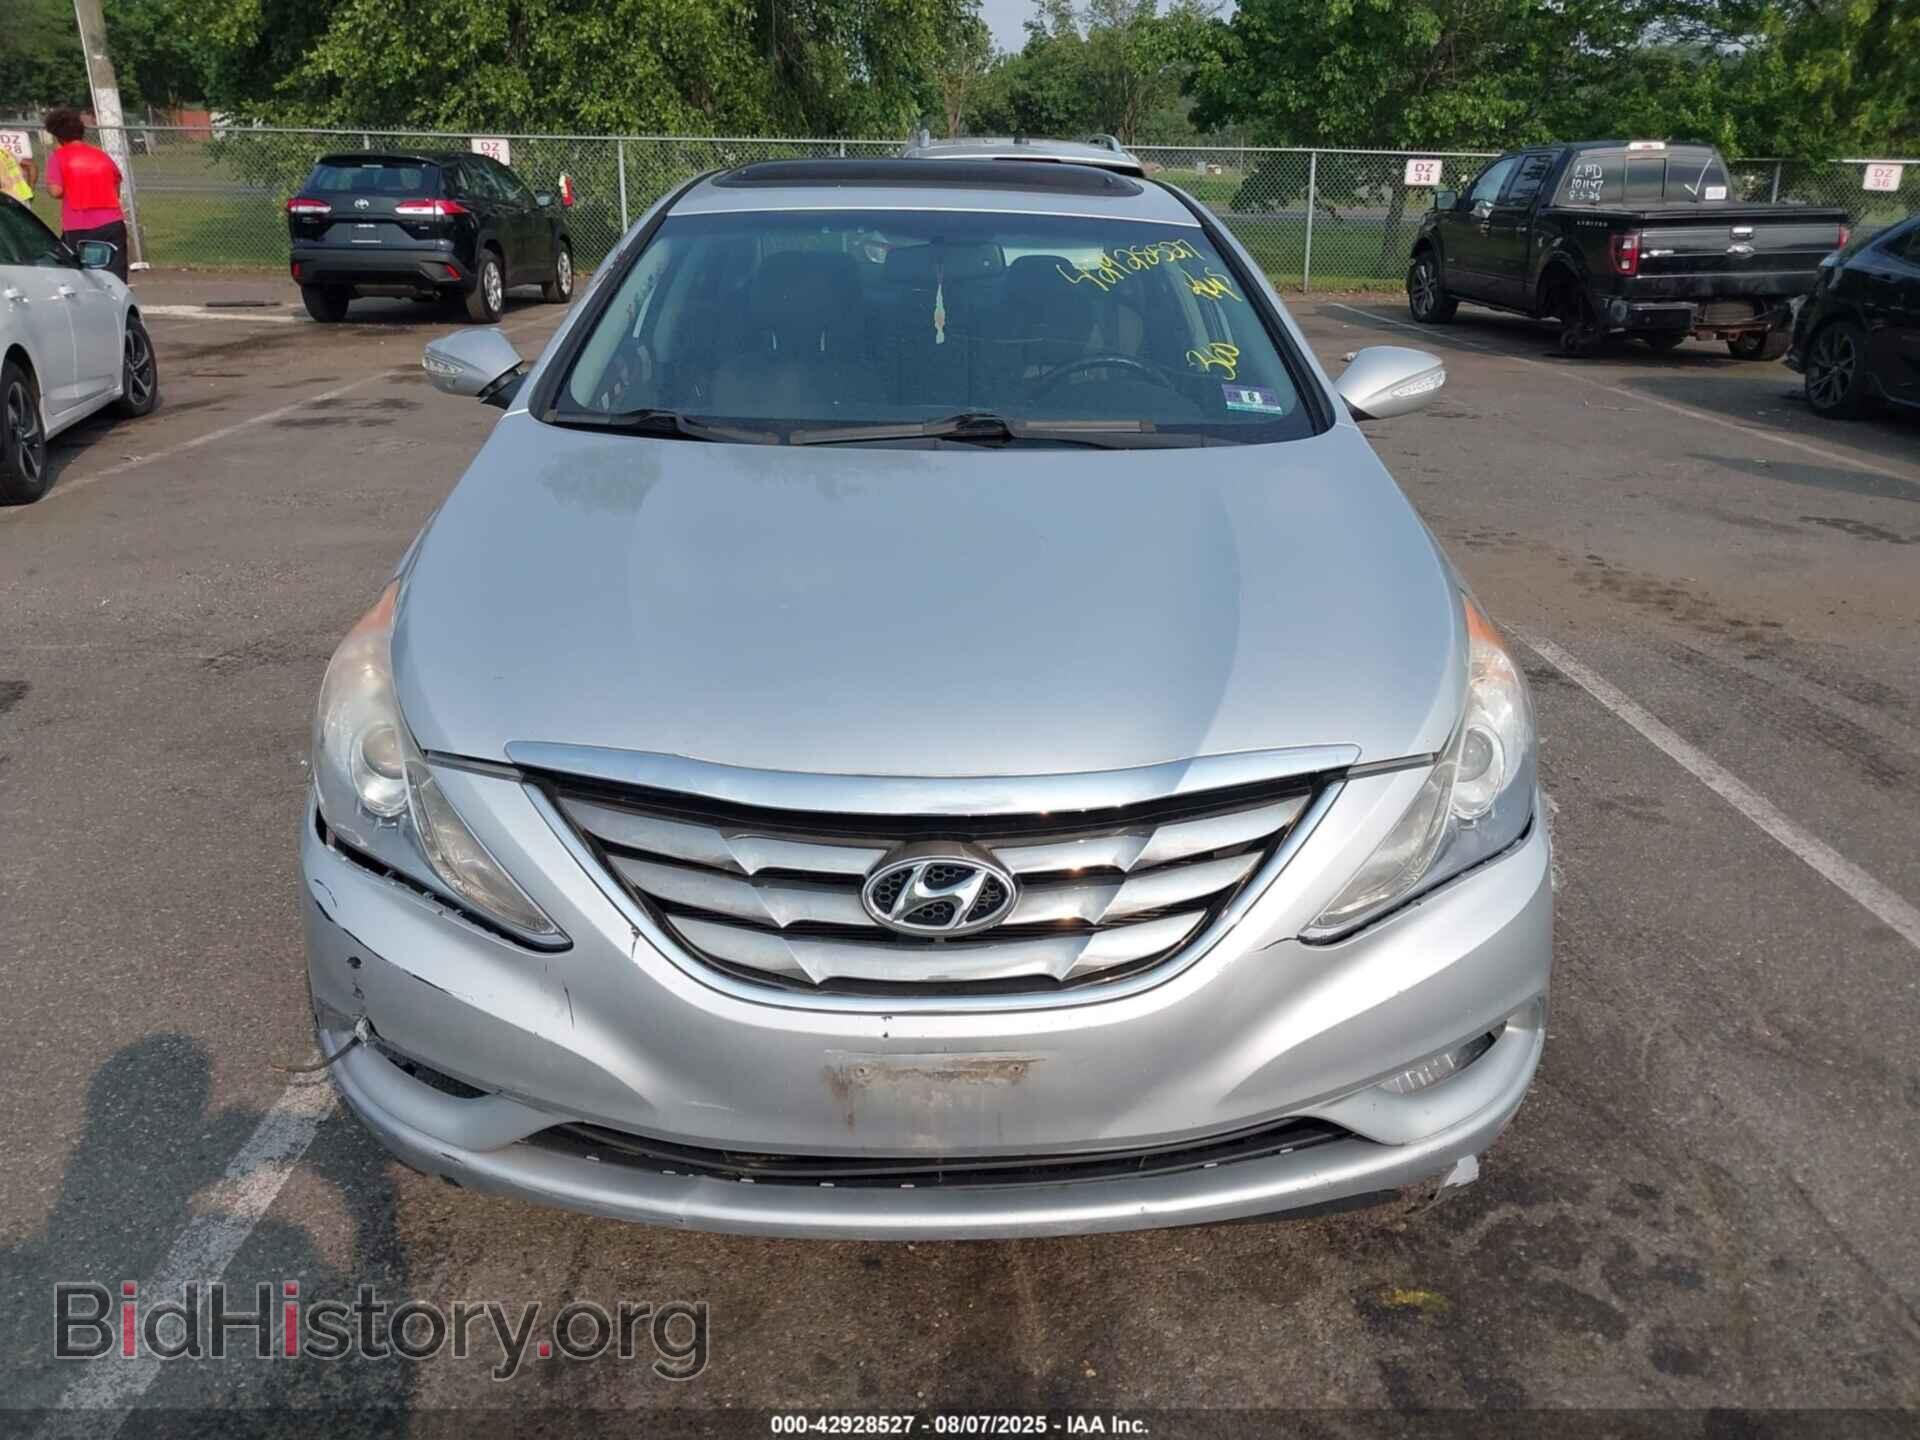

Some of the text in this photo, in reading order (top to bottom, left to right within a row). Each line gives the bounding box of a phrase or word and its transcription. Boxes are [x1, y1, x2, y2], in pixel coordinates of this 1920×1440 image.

[480, 141, 499, 151] DZ
[1415, 163, 1434, 173] DZ
[1873, 168, 1895, 178] DZ
